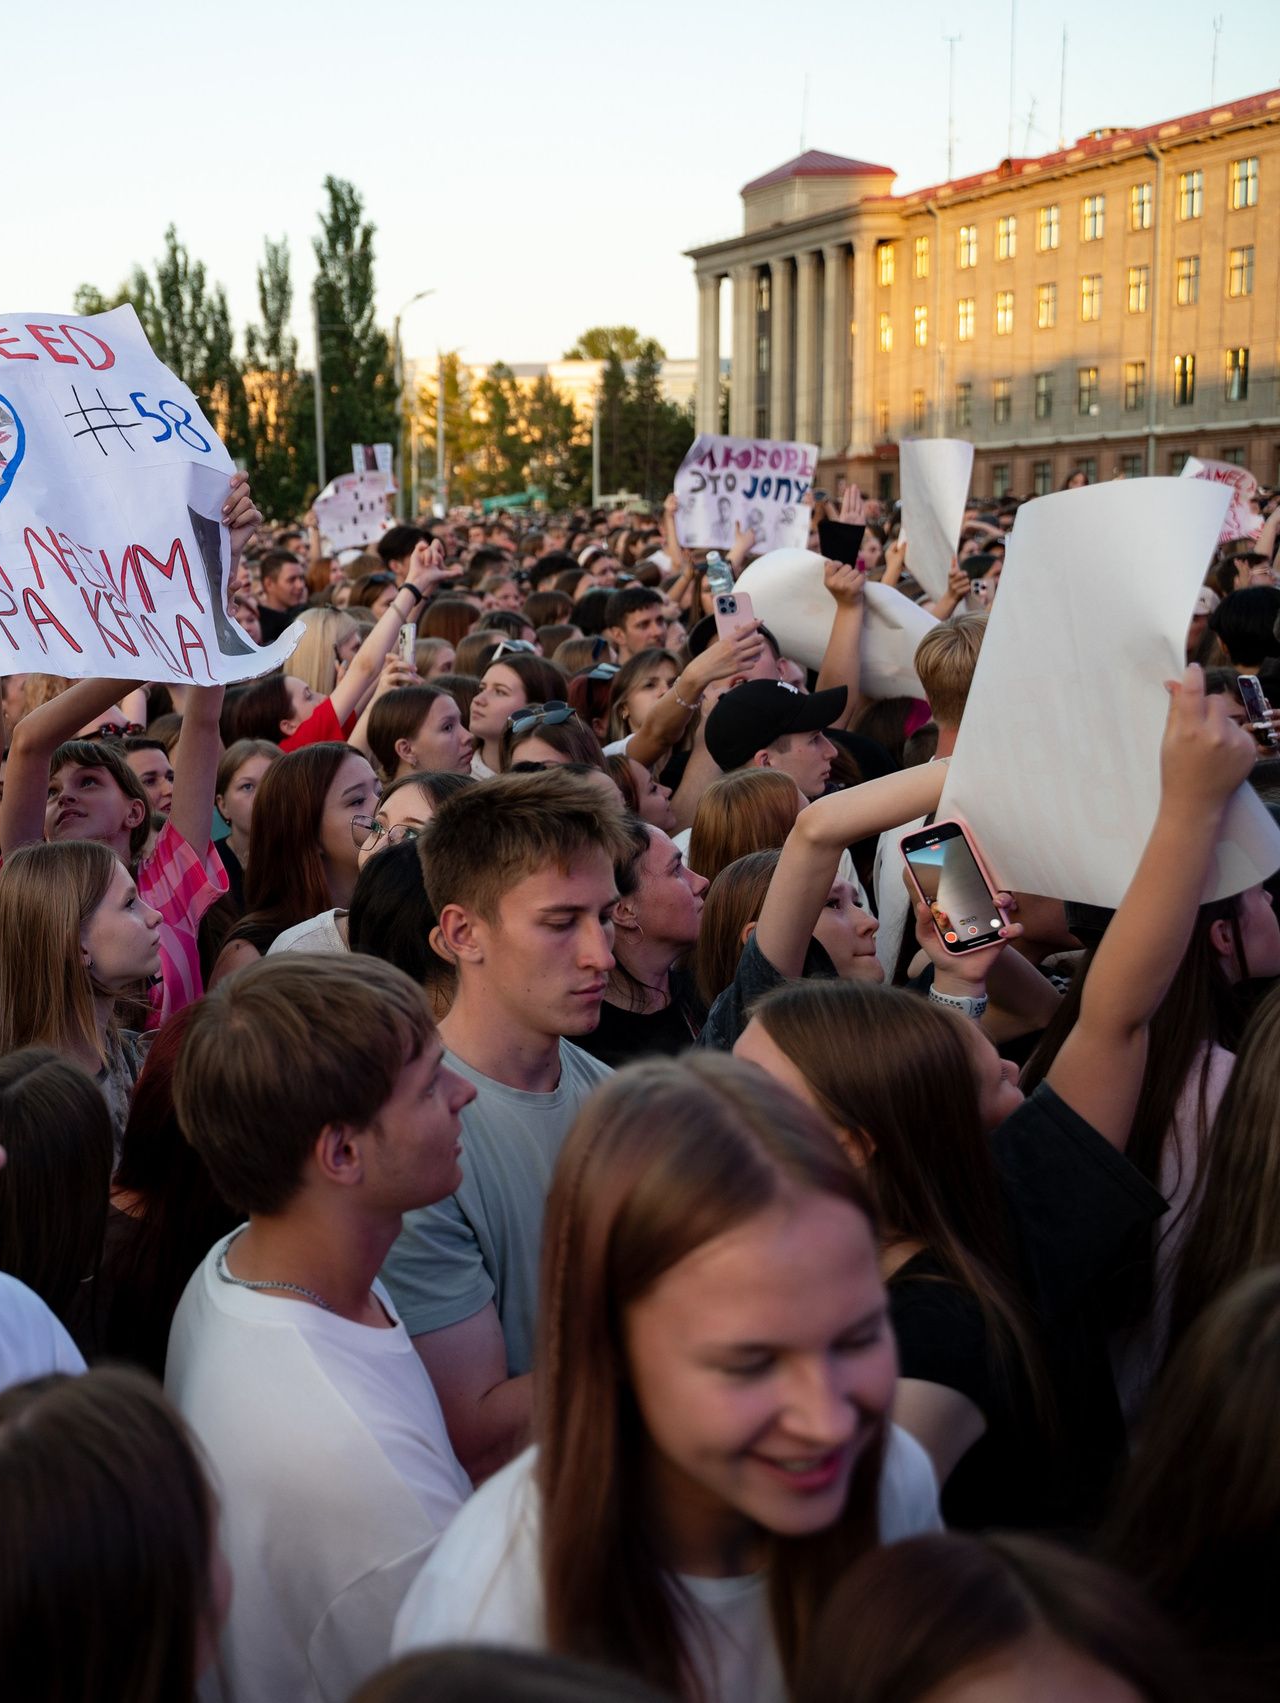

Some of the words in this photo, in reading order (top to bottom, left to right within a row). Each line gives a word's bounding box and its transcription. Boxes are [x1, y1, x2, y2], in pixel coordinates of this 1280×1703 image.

[64, 384, 212, 456] #58
[696, 444, 815, 478] ЛЮБОВЬ
[688, 470, 737, 495] ЭТО
